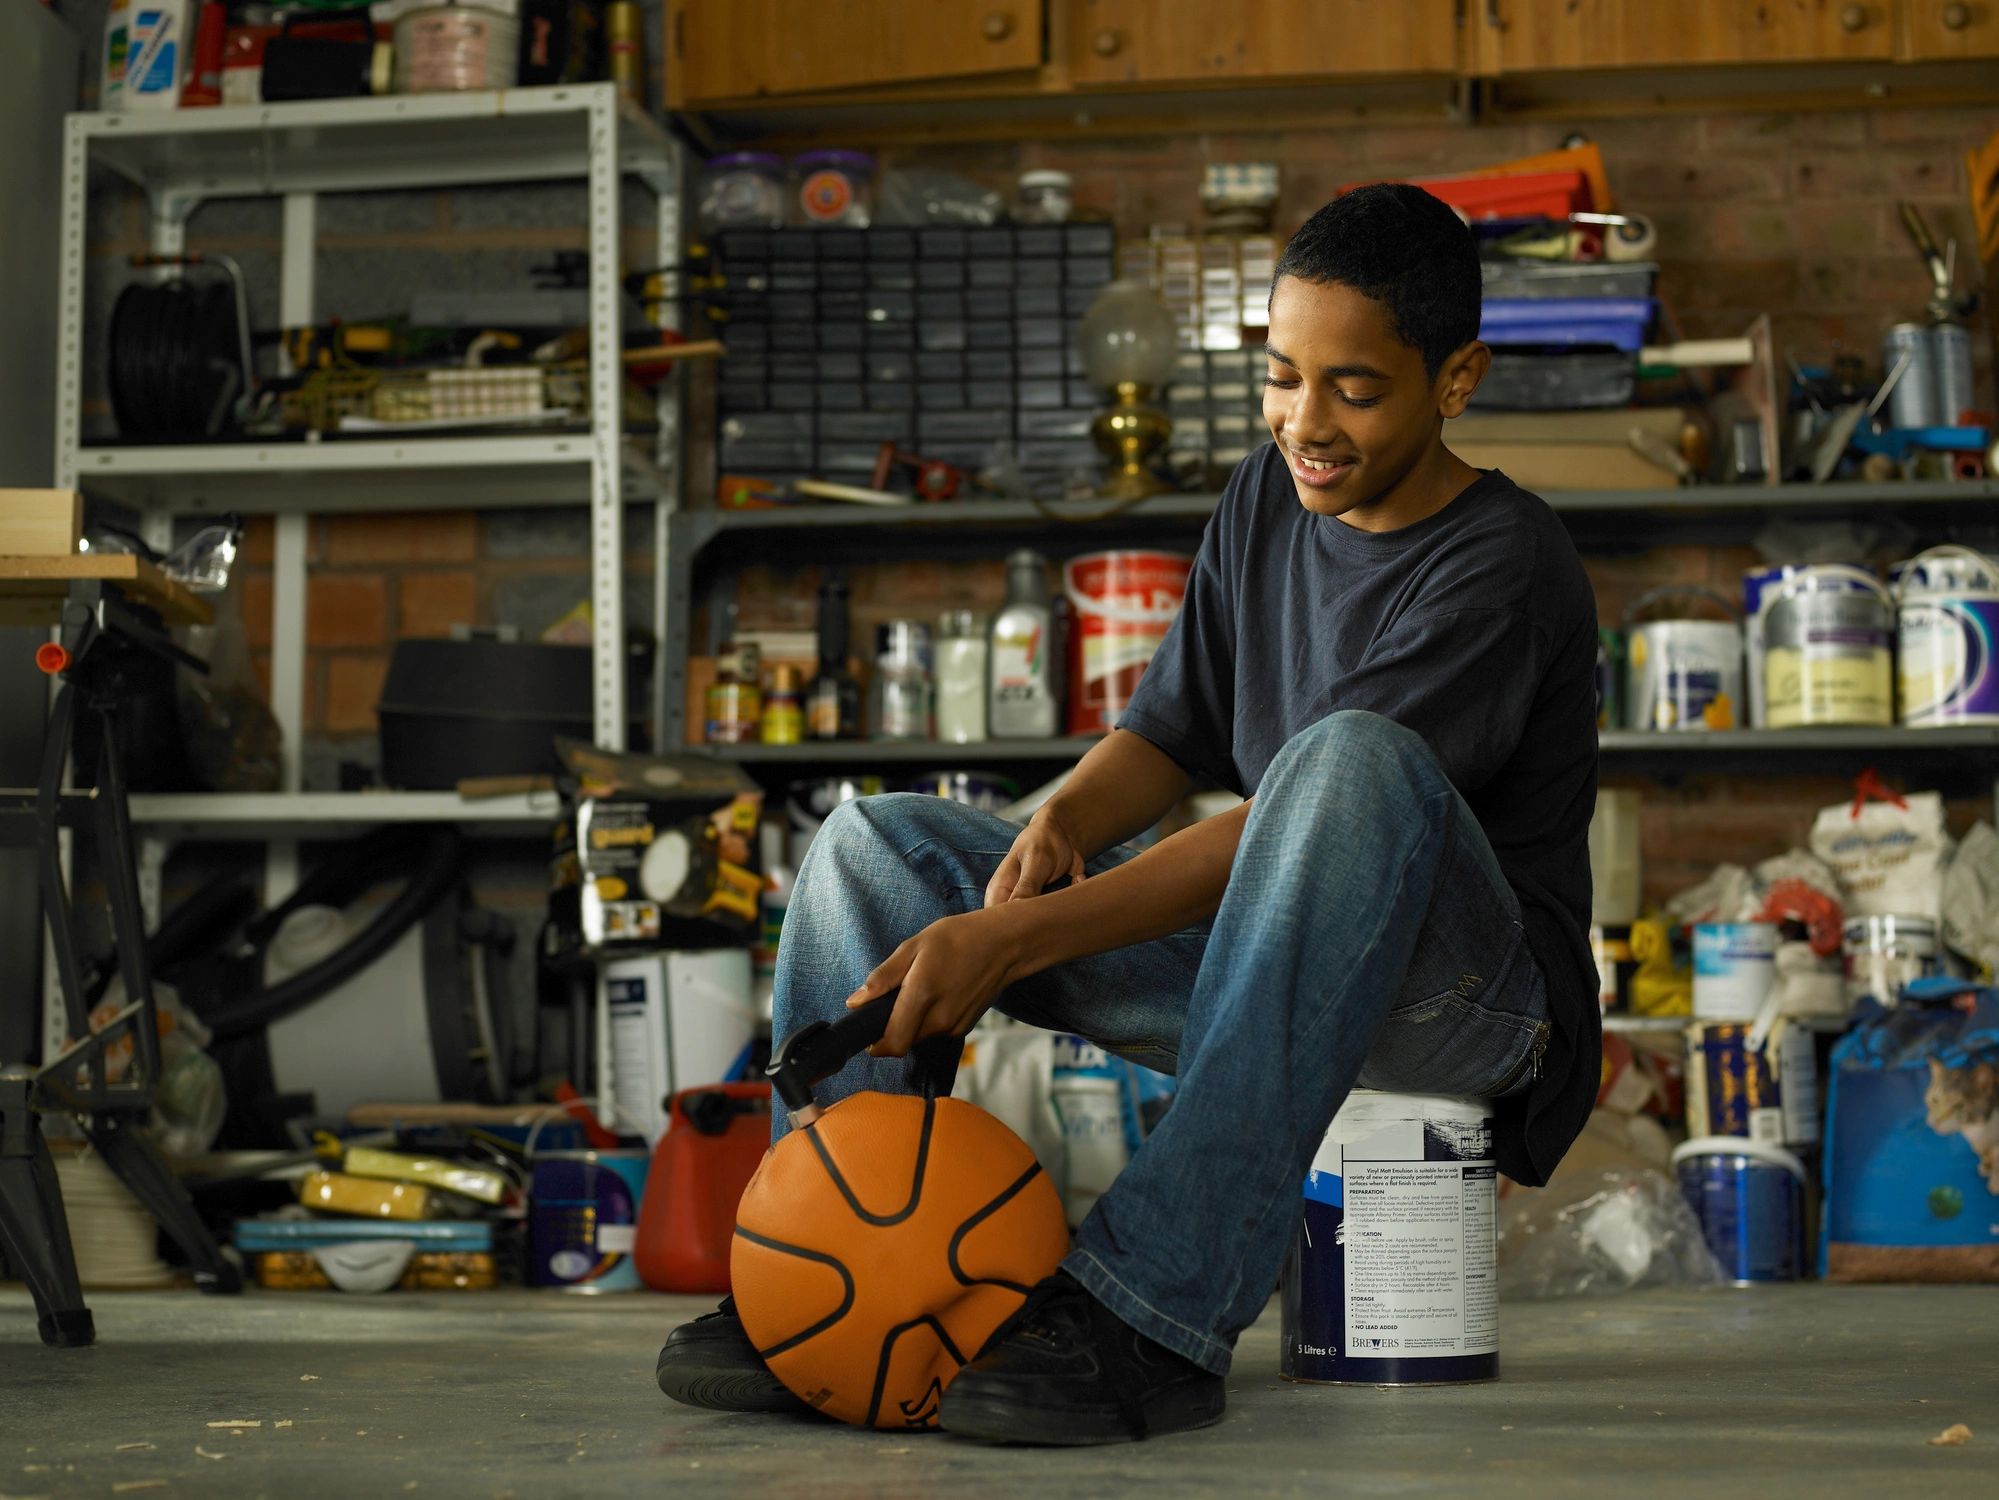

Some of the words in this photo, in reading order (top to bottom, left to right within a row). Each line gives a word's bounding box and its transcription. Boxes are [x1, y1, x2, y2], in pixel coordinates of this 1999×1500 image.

[1352, 1337, 1399, 1348] BREWERS
[1298, 1344, 1302, 1354] 5
[1304, 1345, 1325, 1355] Litres
